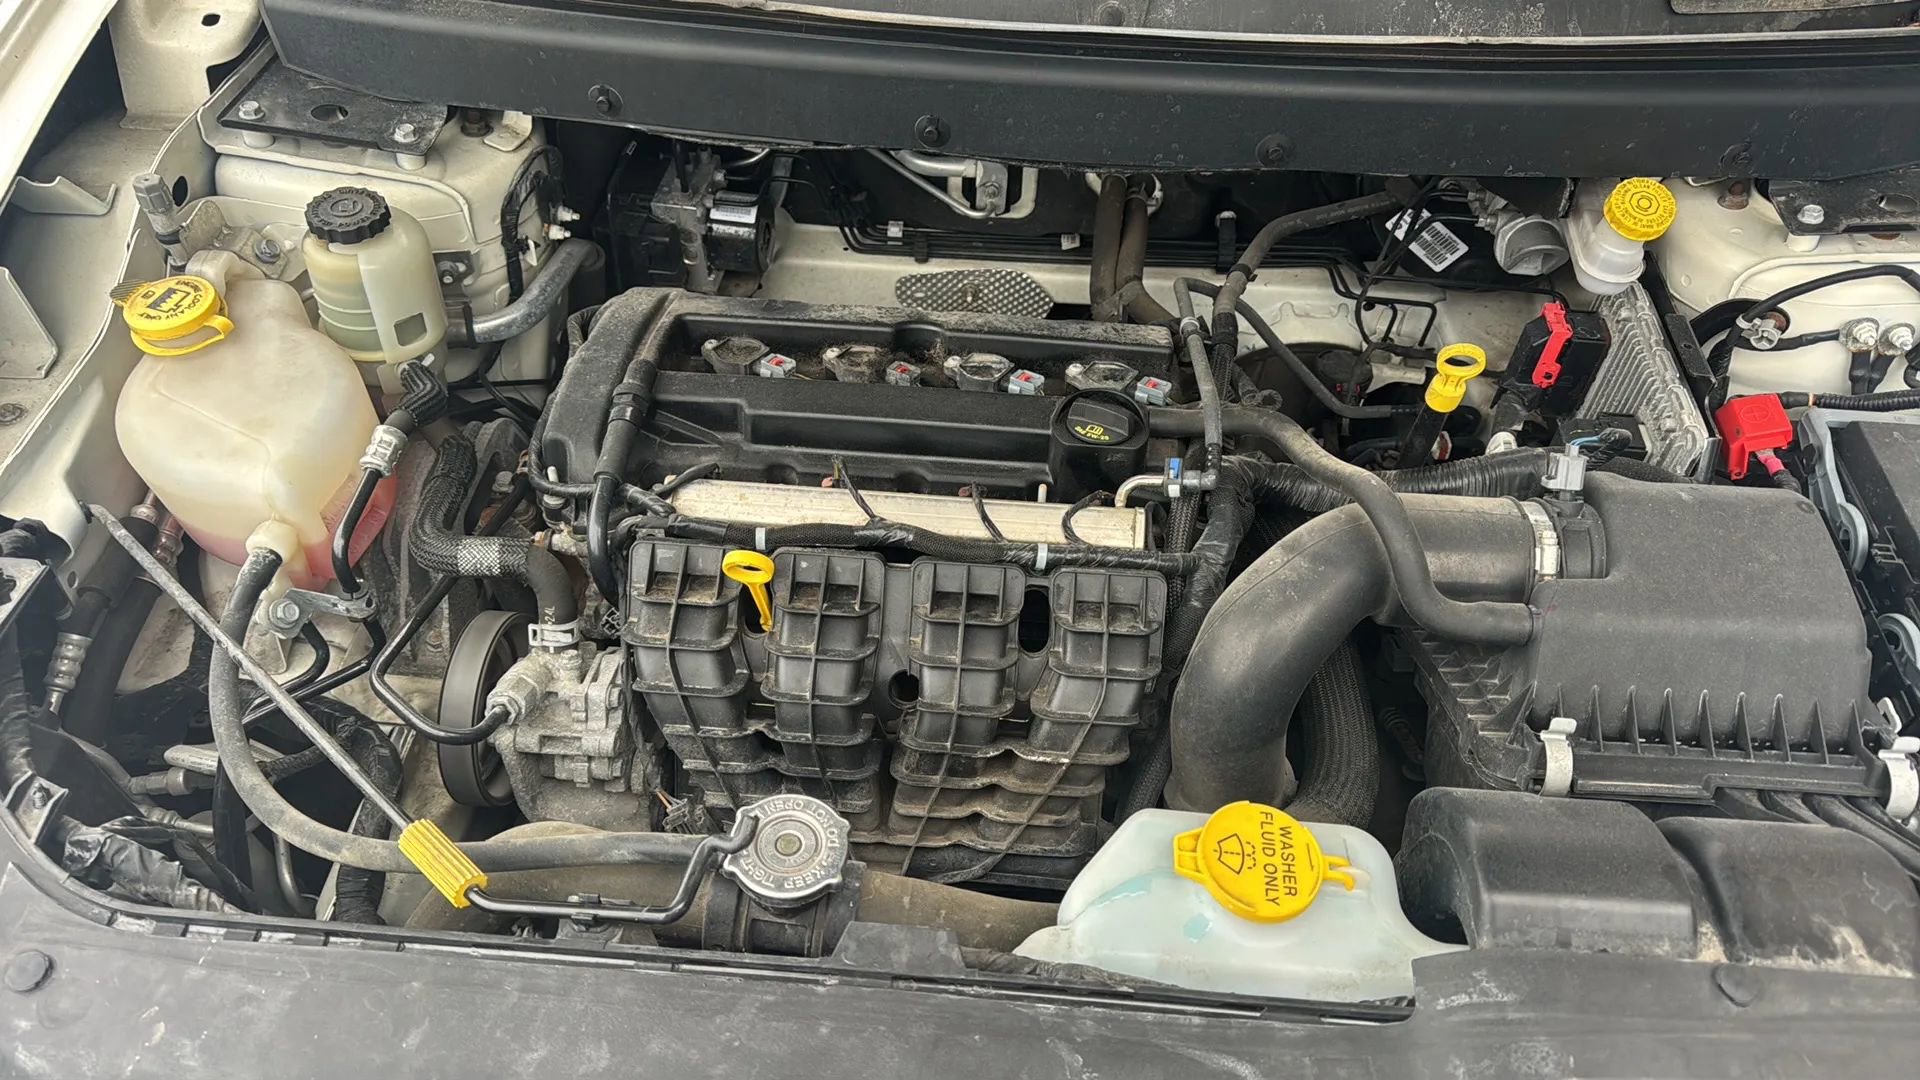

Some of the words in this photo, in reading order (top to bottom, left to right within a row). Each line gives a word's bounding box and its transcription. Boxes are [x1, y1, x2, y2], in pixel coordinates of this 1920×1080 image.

[175, 279, 203, 295] ENGINE
[165, 294, 203, 320] COOLANT
[766, 800, 804, 814] OPEN
[805, 807, 833, 828] NOT
[827, 829, 841, 848] DO
[1259, 811, 1277, 858] FLUID
[740, 857, 775, 888] TIGHT
[1279, 825, 1298, 898] WASHER
[784, 867, 826, 889] KEEP
[1263, 863, 1281, 907] ONLY
